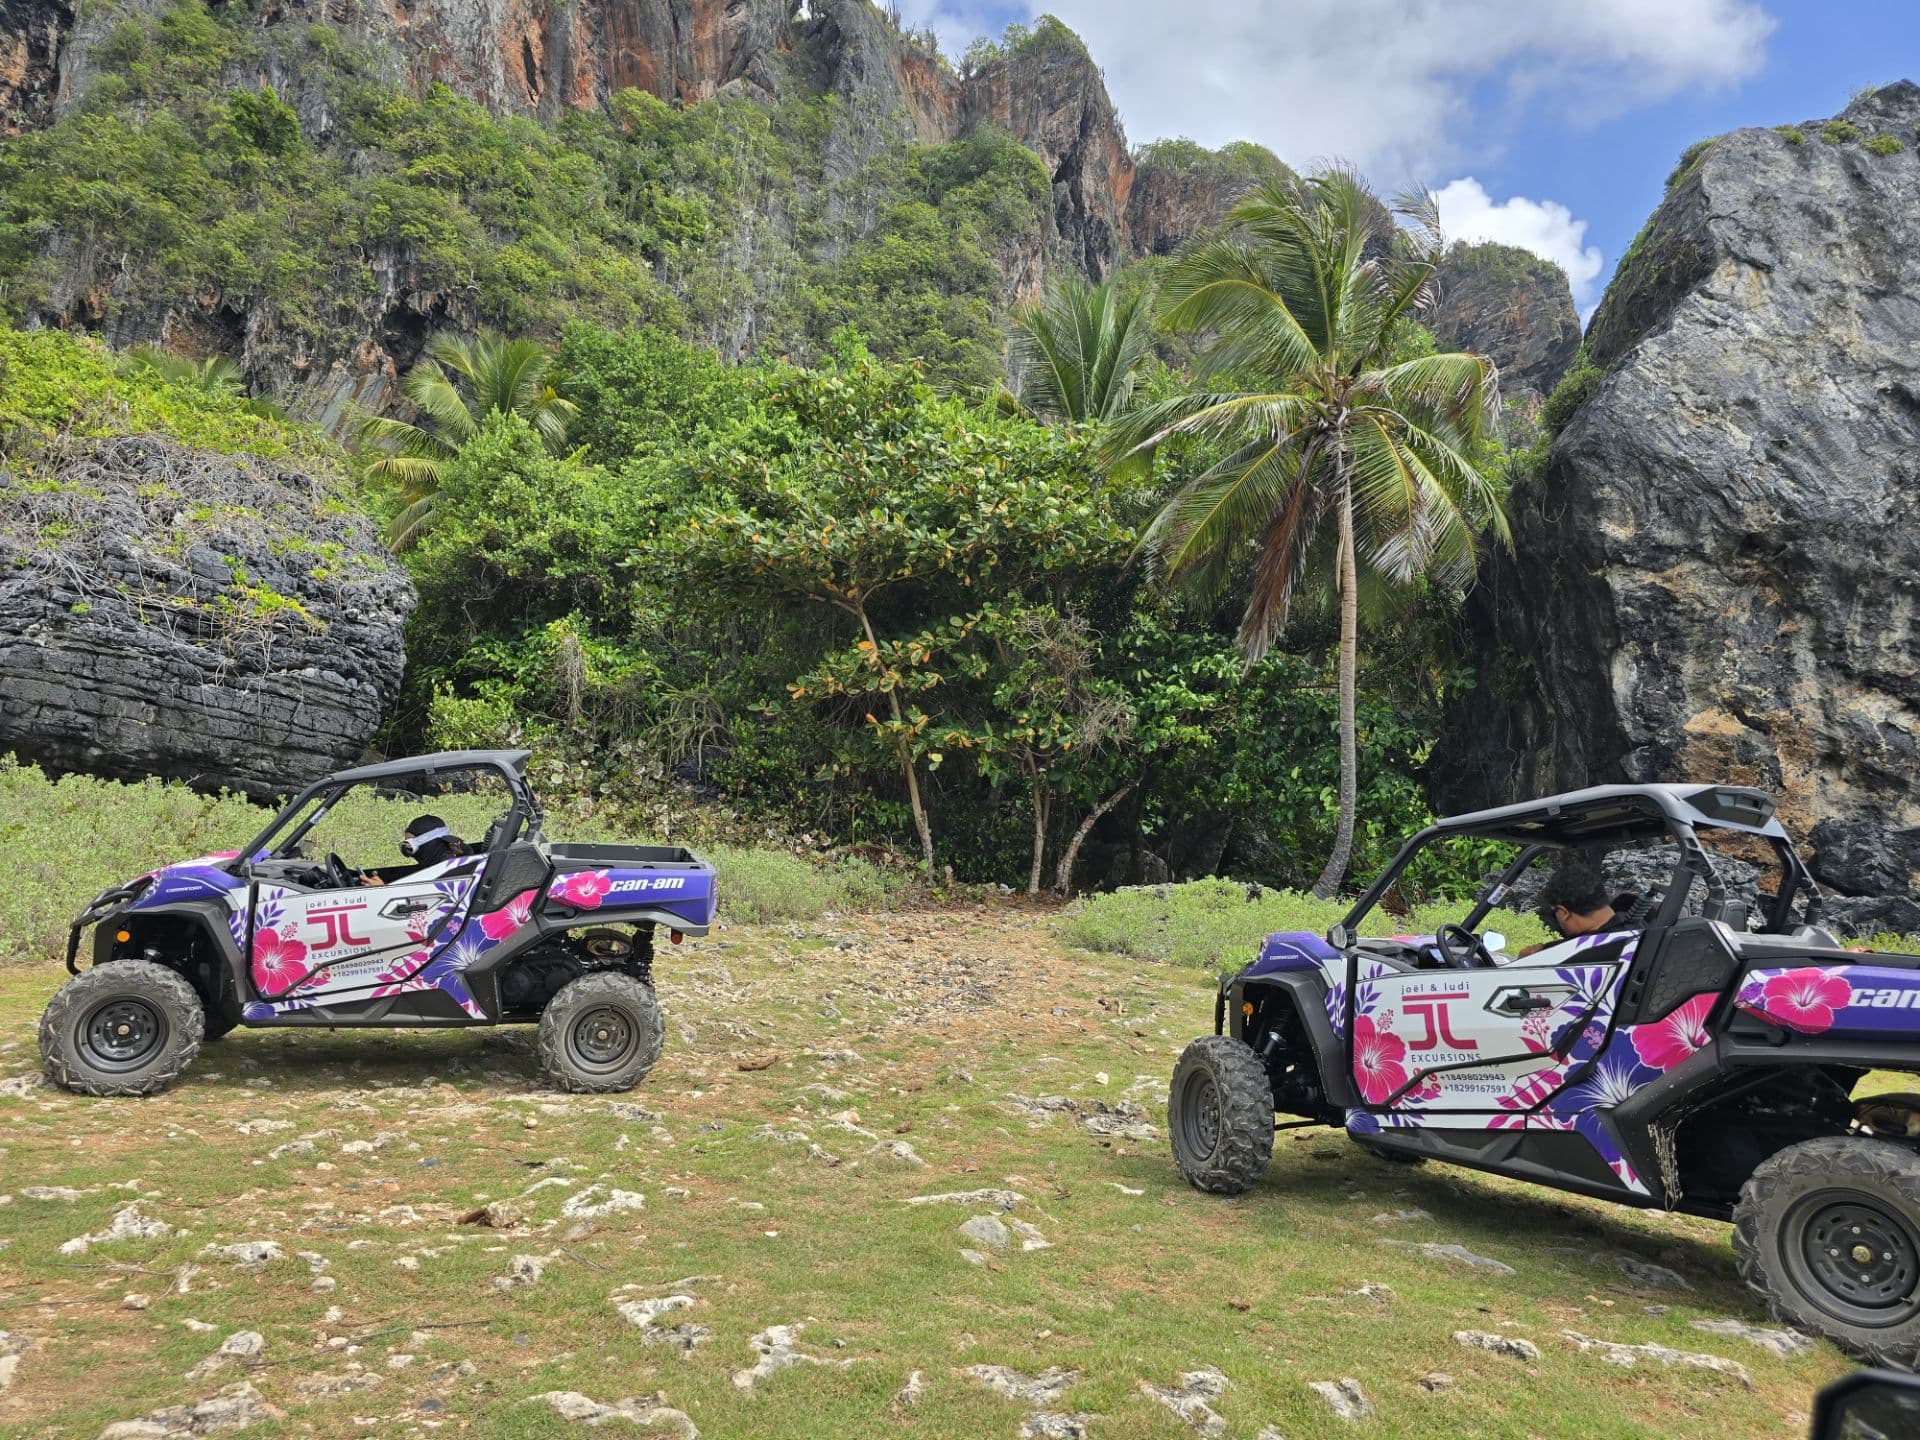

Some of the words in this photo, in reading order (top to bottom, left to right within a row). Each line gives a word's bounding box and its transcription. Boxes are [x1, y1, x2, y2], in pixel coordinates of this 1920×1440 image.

[609, 877, 685, 892] can-am
[1430, 983, 1437, 992] &
[1411, 1053, 1481, 1063] EXCURSIONS
[1444, 1084, 1506, 1093] +18299167591
